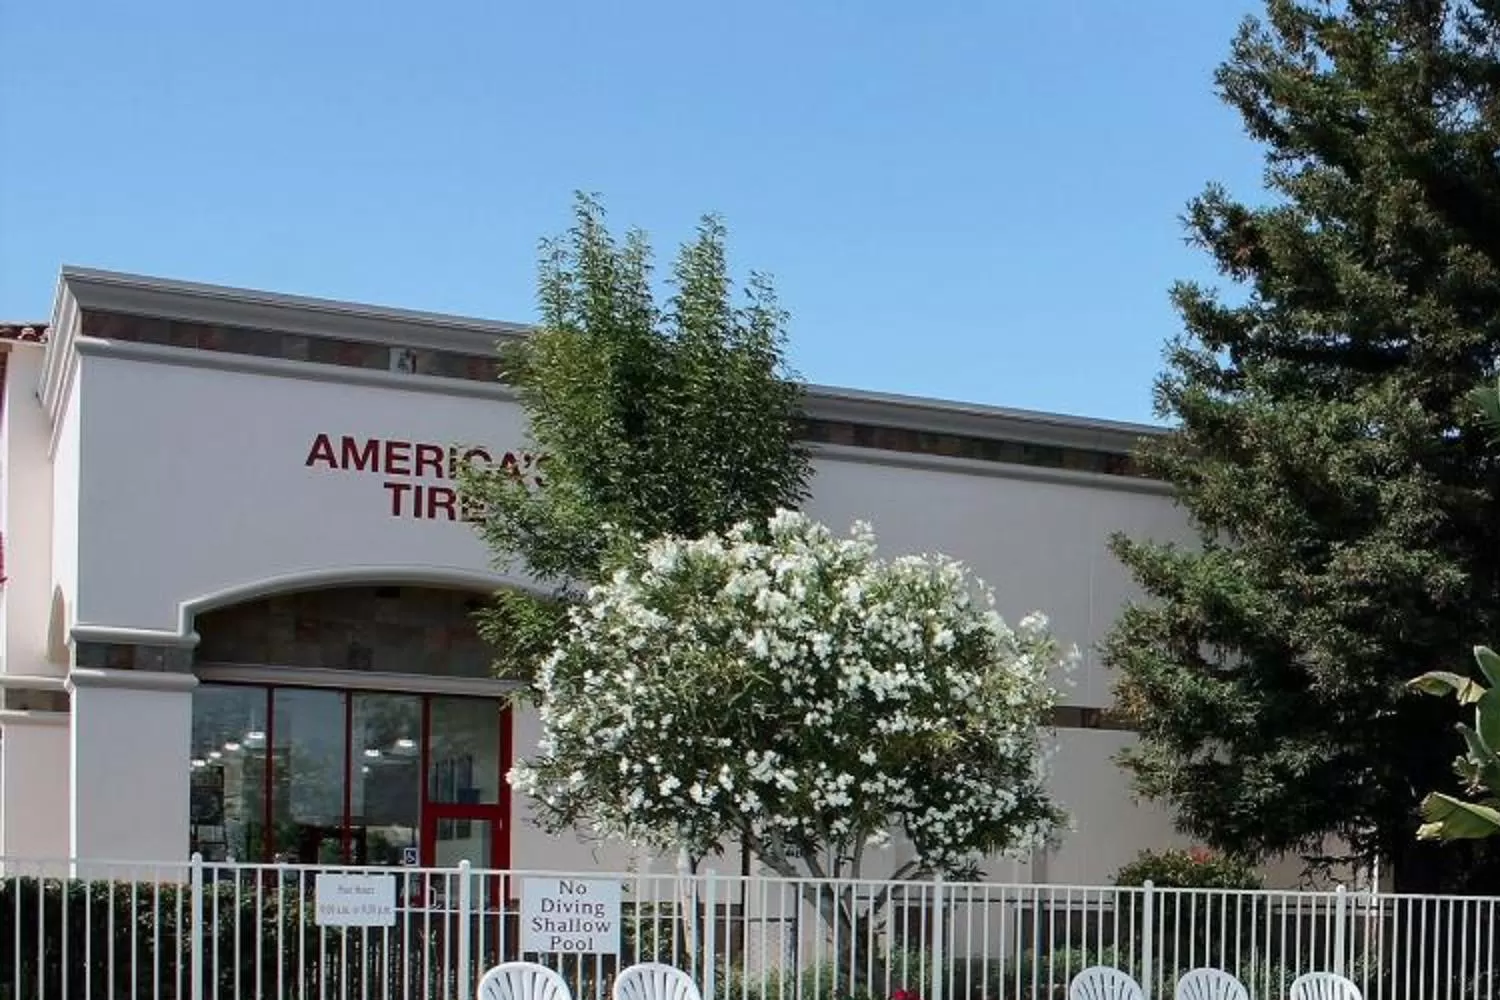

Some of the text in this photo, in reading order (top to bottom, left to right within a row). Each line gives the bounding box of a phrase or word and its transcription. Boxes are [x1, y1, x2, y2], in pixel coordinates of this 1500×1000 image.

[559, 880, 587, 895] No
[541, 898, 605, 918] Diving
[532, 917, 611, 933] Shallow
[550, 935, 594, 951] Pool
